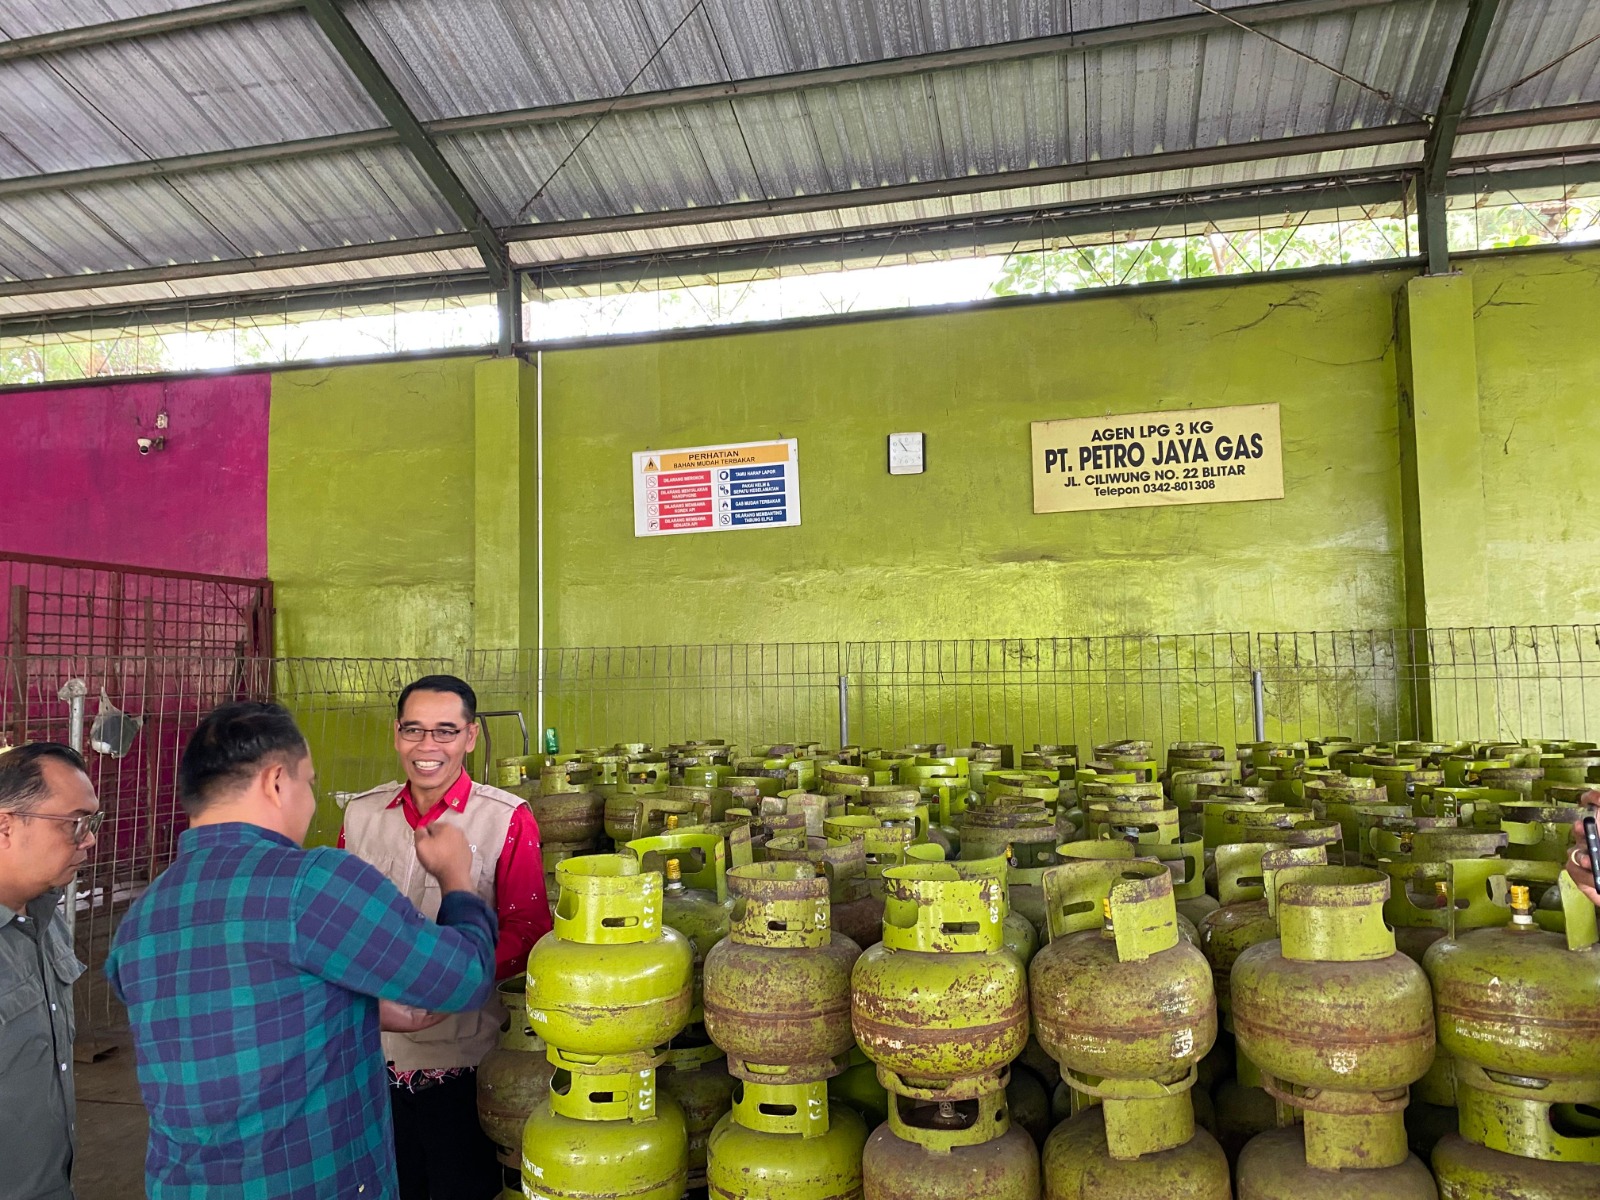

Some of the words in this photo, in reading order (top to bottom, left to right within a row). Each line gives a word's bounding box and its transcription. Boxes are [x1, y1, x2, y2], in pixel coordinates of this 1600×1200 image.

[1091, 427, 1135, 442] AGEN
[1140, 424, 1170, 438] LPG
[1175, 423, 1184, 435] 3
[1190, 421, 1214, 434] KG
[689, 451, 739, 460] PERHATIAN
[1045, 448, 1073, 473] PT.
[1080, 442, 1145, 471] PETRO
[1152, 437, 1209, 466] JAYA
[1215, 433, 1263, 461] GAS
[1064, 476, 1080, 487] JL.
[1085, 470, 1150, 485] CILIWUNG
[1155, 468, 1179, 481] NO.
[1184, 468, 1199, 479] 22
[1202, 464, 1245, 478] BLITAR
[1094, 485, 1139, 497] Telepon
[1143, 480, 1215, 493] 0342-801308
[990, 884, 999, 924] 01-29
